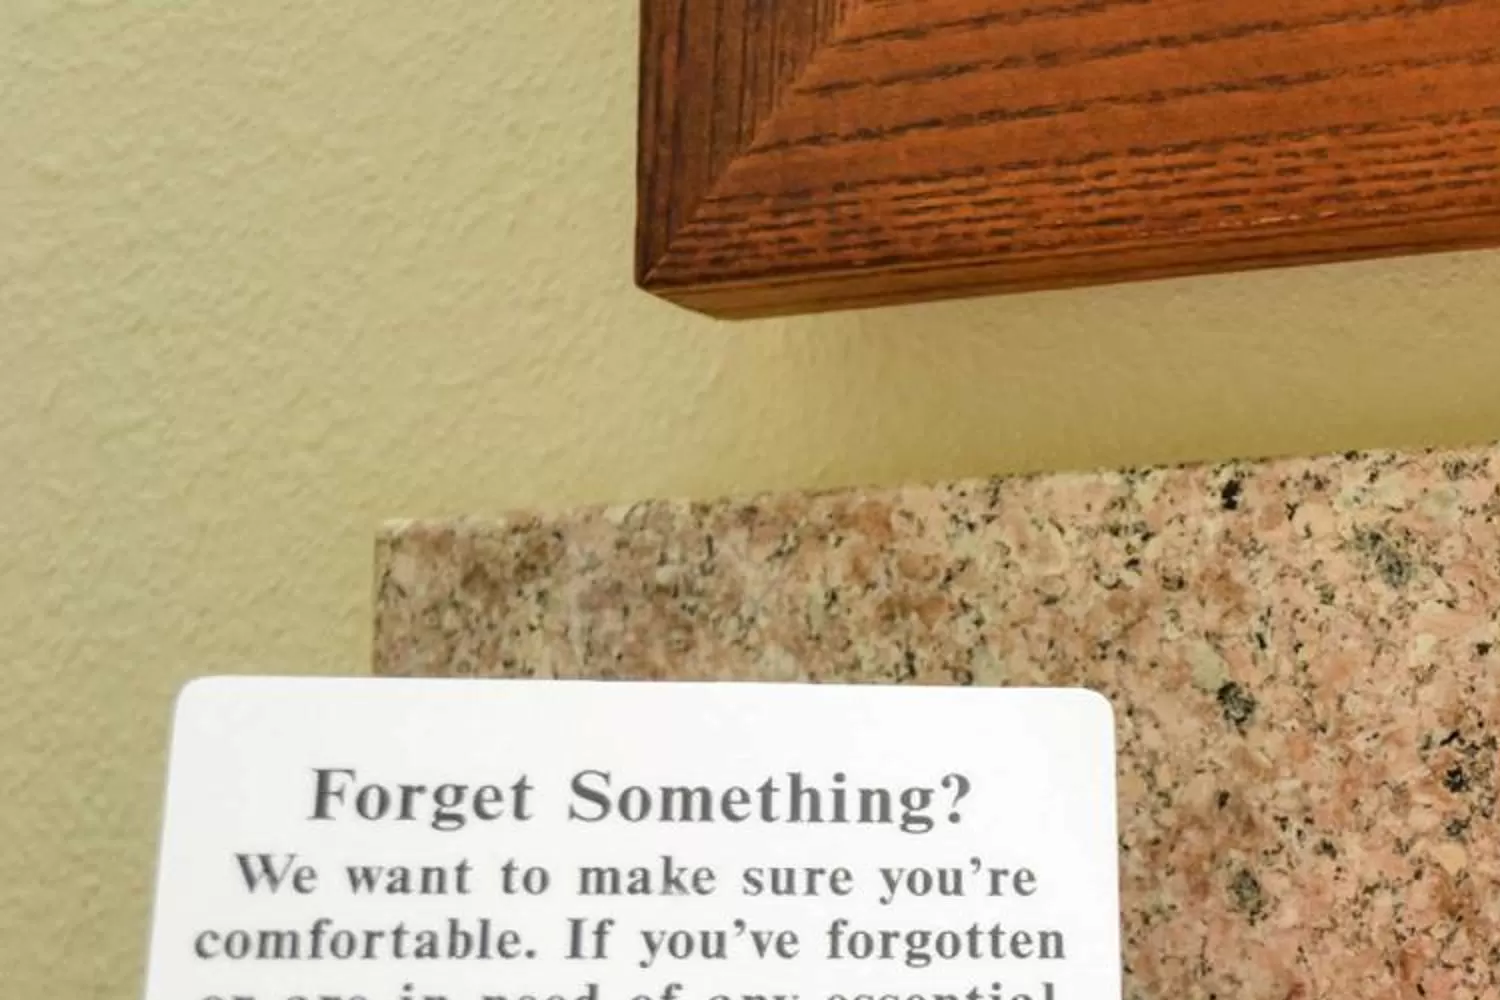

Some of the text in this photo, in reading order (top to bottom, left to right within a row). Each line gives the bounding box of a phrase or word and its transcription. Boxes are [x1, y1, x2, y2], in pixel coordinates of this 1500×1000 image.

[310, 767, 971, 835] Forget Something?
[234, 852, 1037, 907] We want to make sure you're
[193, 916, 1066, 970] comfortable. If you've forgotten
